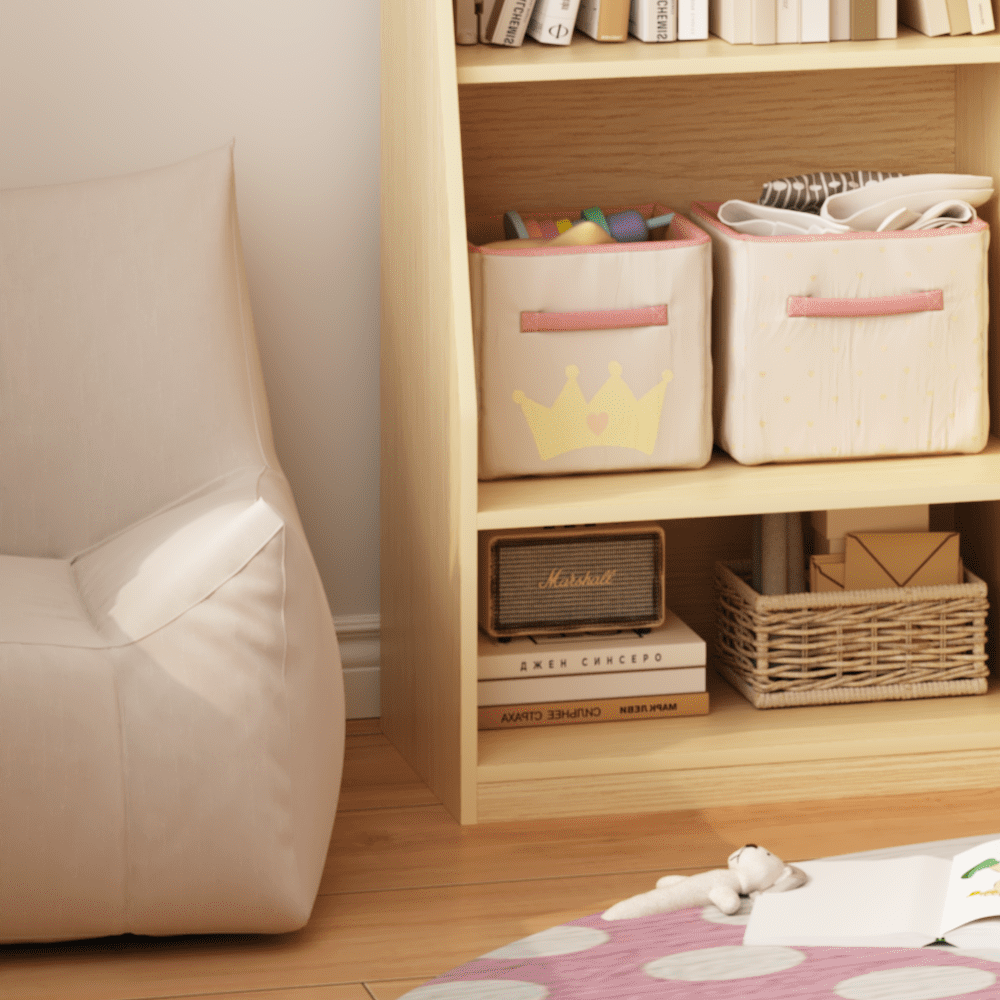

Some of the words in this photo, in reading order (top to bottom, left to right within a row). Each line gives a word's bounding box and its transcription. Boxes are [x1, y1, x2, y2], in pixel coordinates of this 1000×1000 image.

[537, 567, 617, 590] Marshall
[520, 658, 568, 673] ДЖЕН
[581, 652, 663, 667] СИНСЕРО
